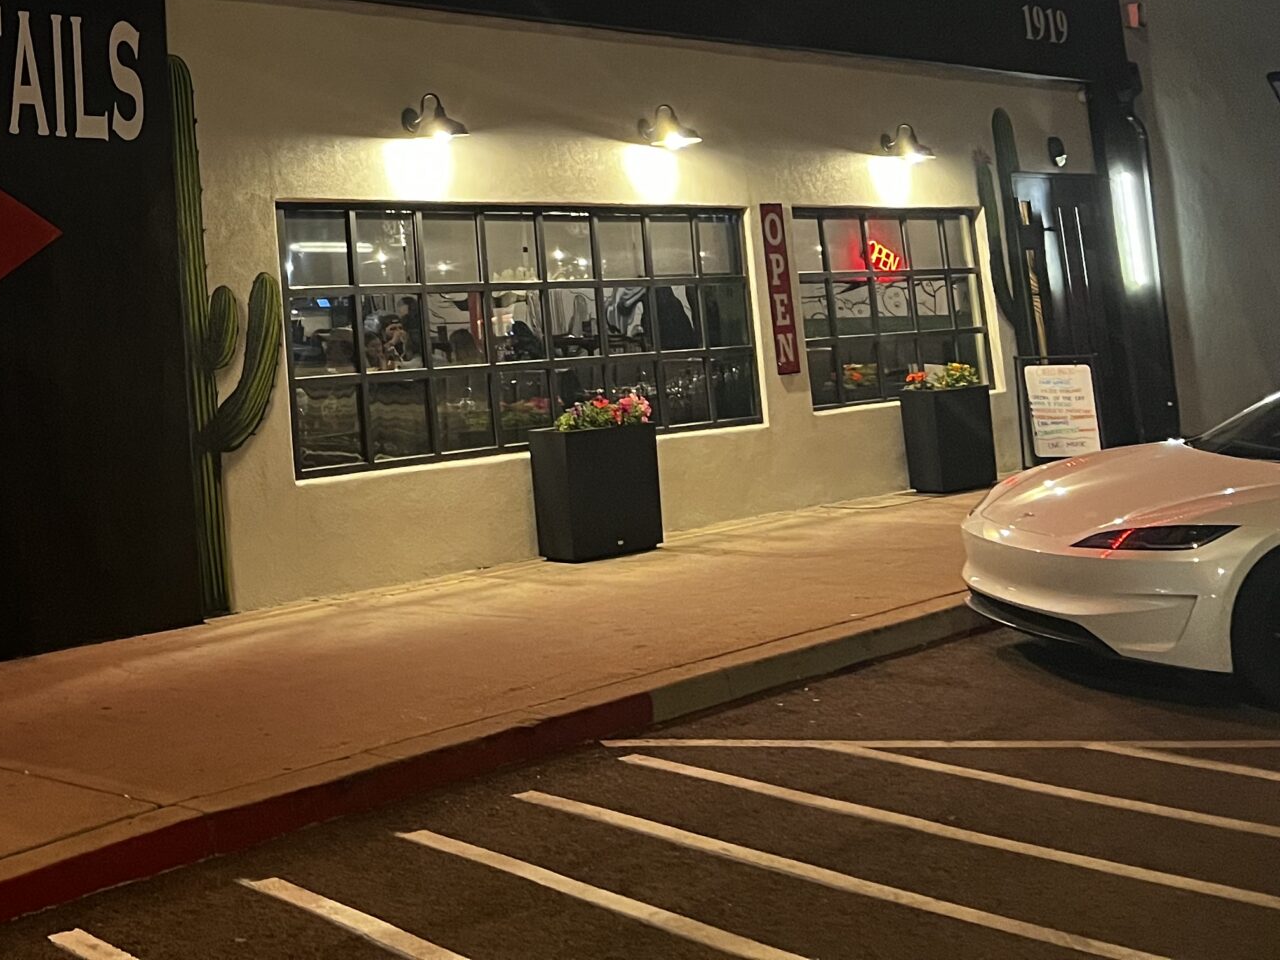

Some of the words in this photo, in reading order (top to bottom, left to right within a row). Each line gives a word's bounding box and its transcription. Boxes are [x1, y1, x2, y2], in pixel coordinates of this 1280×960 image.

[1021, 4, 1068, 43] 1919
[868, 240, 900, 271] OPEN
[763, 212, 795, 363] OPEN
